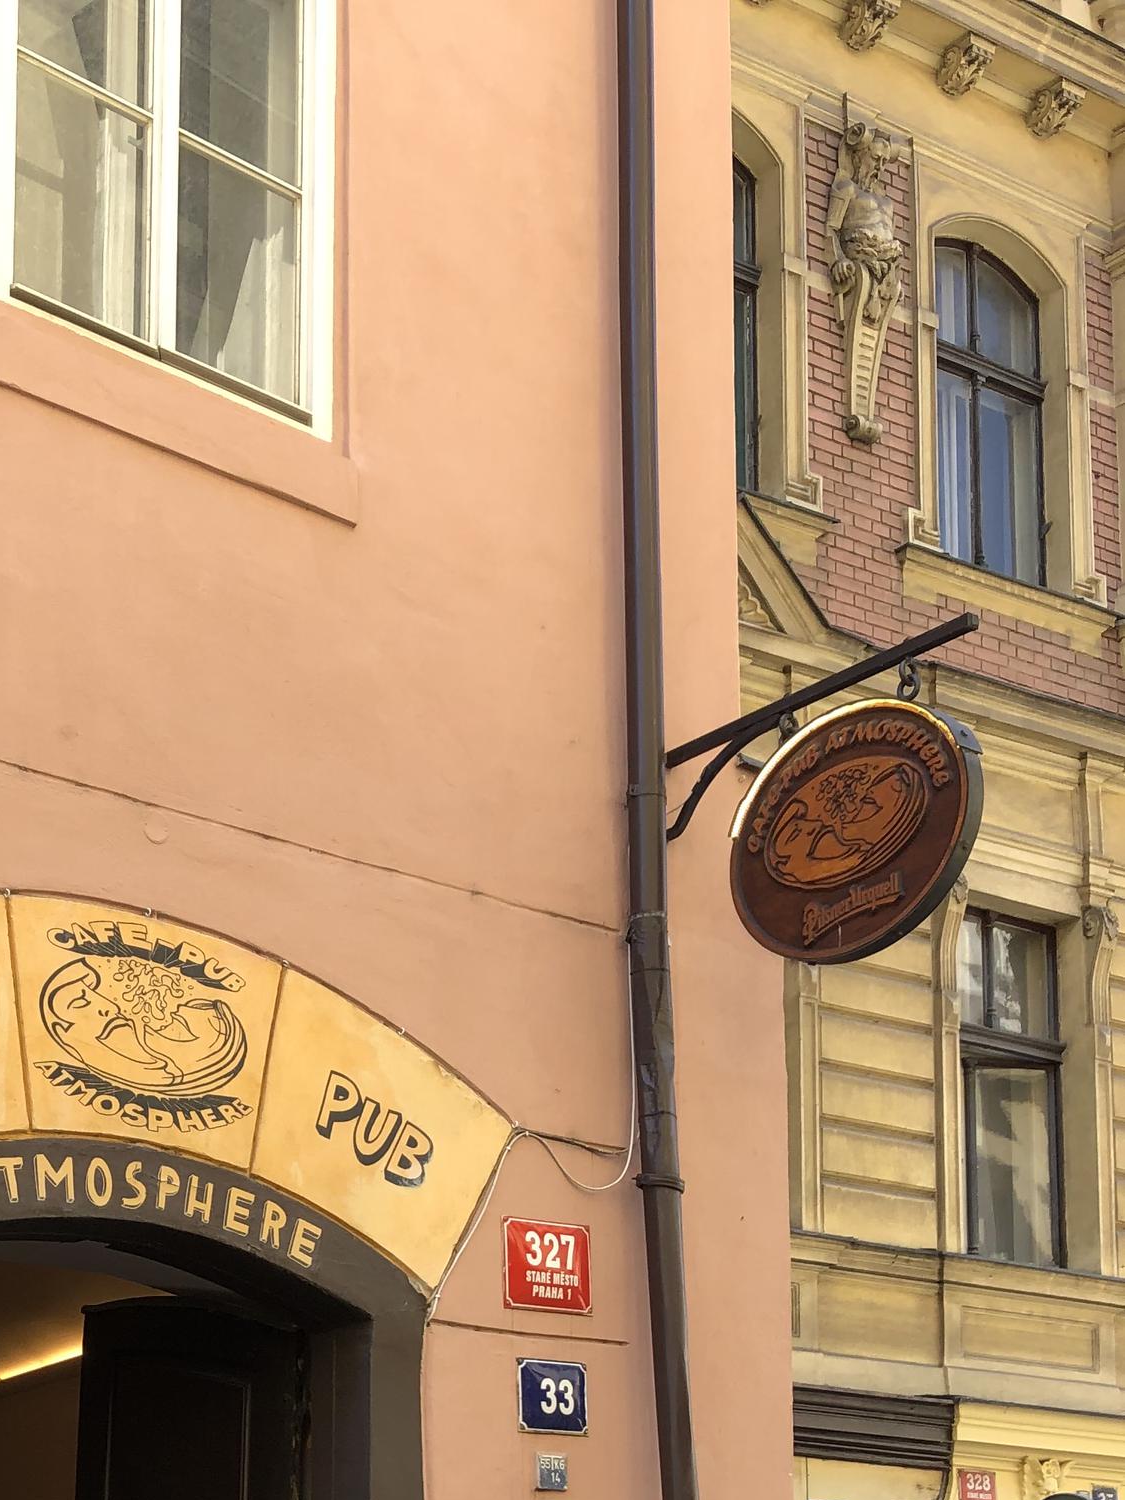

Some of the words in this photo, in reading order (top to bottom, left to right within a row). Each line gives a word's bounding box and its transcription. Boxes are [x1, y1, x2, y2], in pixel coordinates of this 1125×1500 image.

[33, 1060, 254, 1132] ATMOSPHERE
[315, 1070, 434, 1188] PUB
[525, 1230, 575, 1271] 327
[526, 1269, 552, 1284] STARÉ
[553, 1270, 579, 1287] MĚSTO
[532, 1284, 564, 1300] PRAHA
[567, 1288, 573, 1301] 1
[540, 1377, 575, 1415] 33
[966, 1473, 991, 1491] 328
